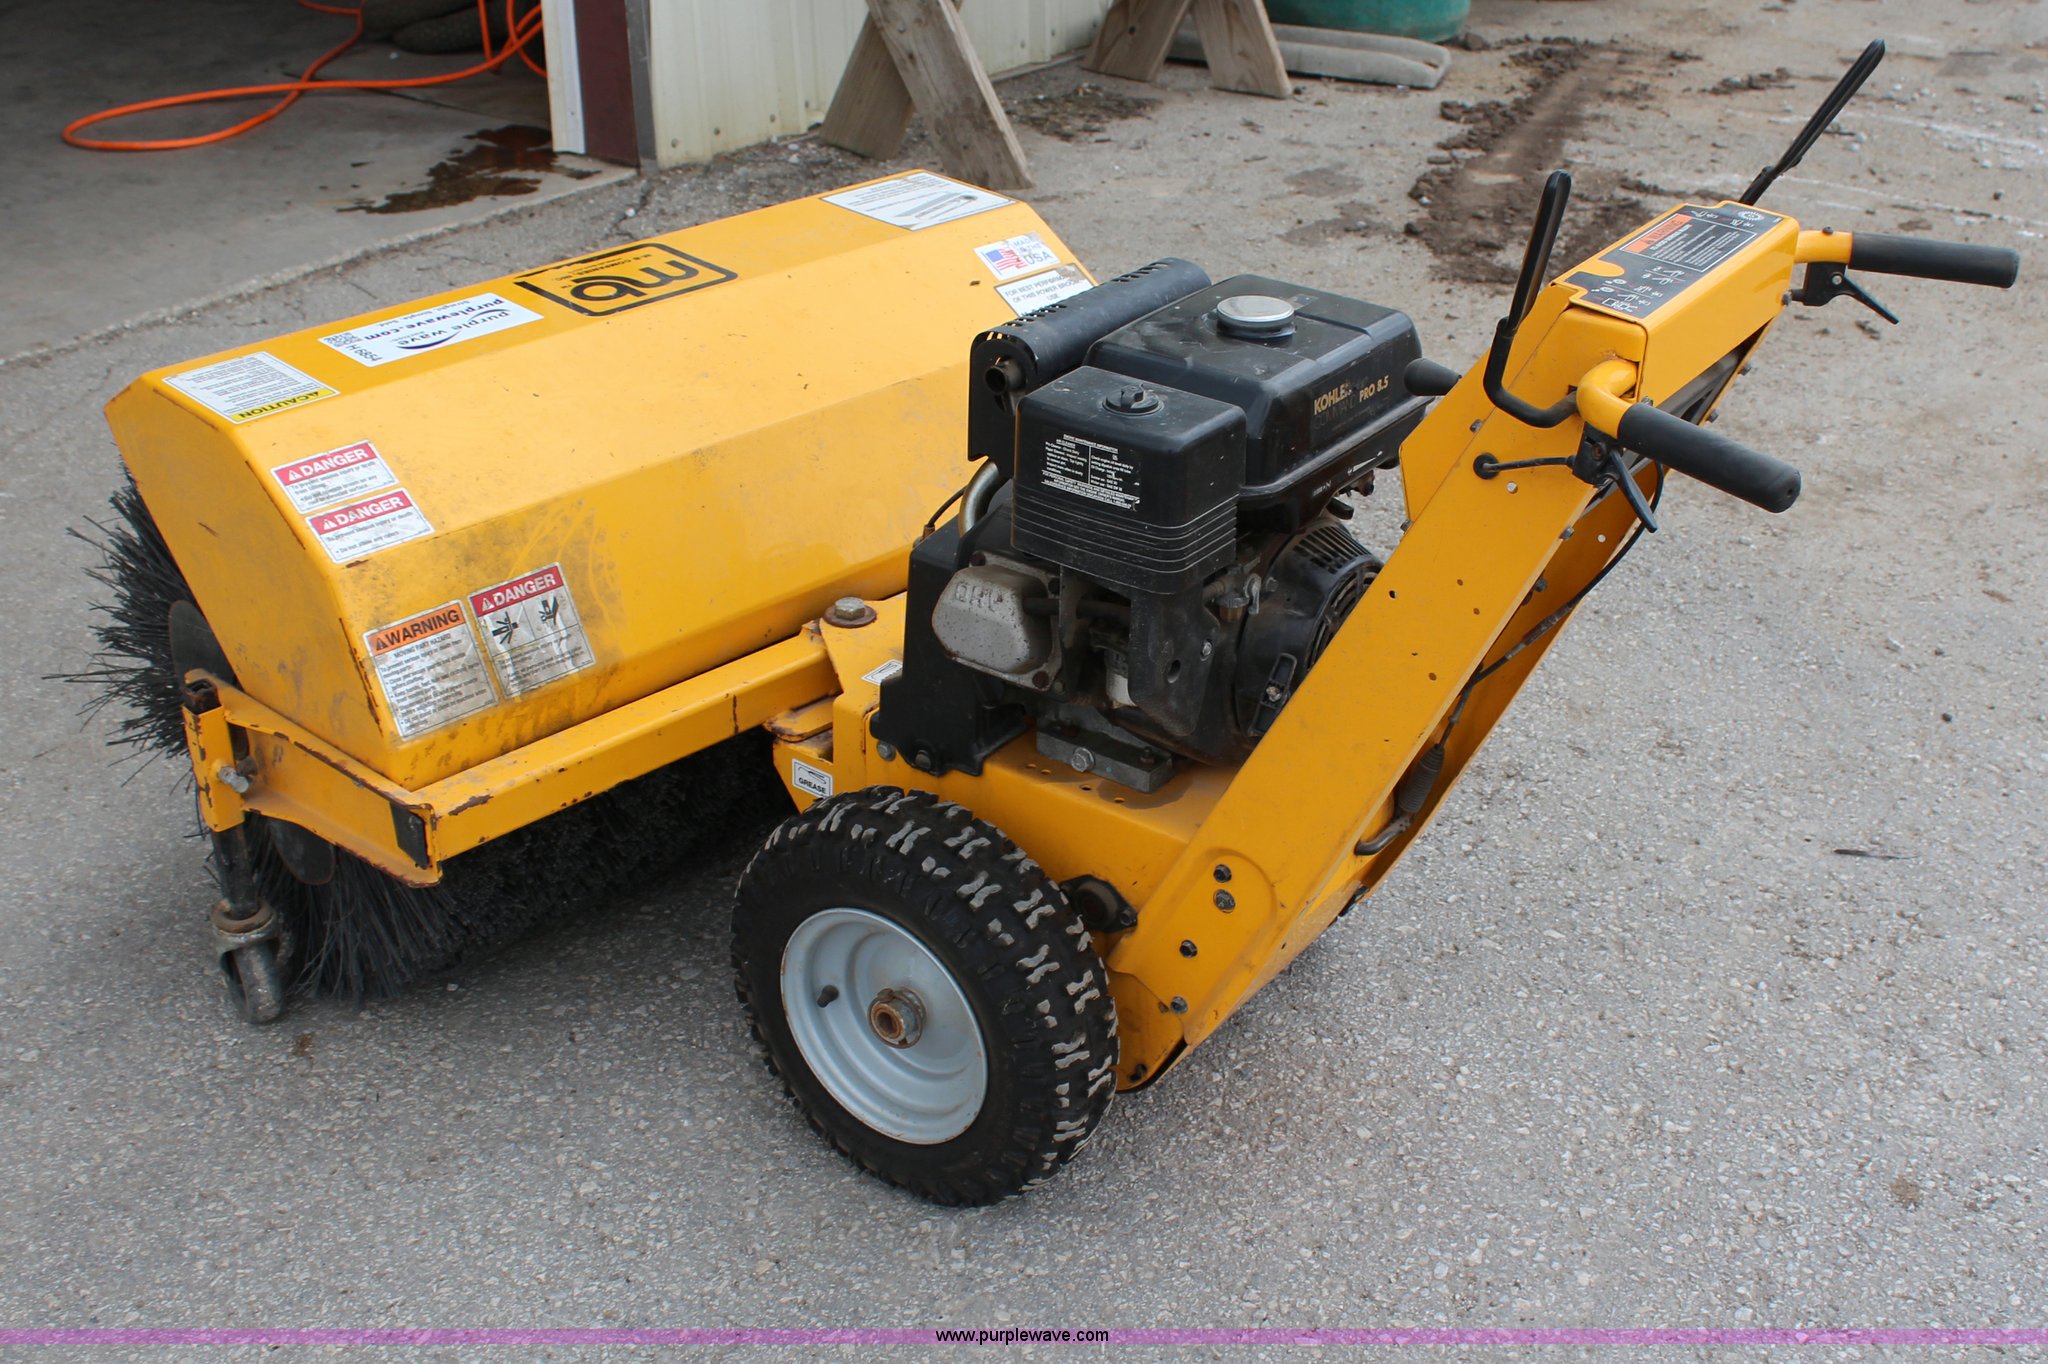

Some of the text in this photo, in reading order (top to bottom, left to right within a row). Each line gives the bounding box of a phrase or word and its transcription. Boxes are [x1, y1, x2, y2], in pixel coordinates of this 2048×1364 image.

[1023, 251, 1053, 264] USA
[364, 298, 504, 341] purplewave.com
[398, 310, 510, 345] purple wave
[1359, 383, 1375, 402] PRO
[1377, 375, 1389, 392] 8.5
[239, 395, 309, 418] CAUTION
[300, 448, 368, 476] DANGER
[334, 496, 404, 525] DANGER
[493, 573, 556, 606] DANGER
[385, 609, 459, 645] WARNING
[798, 777, 826, 794] GREASE
